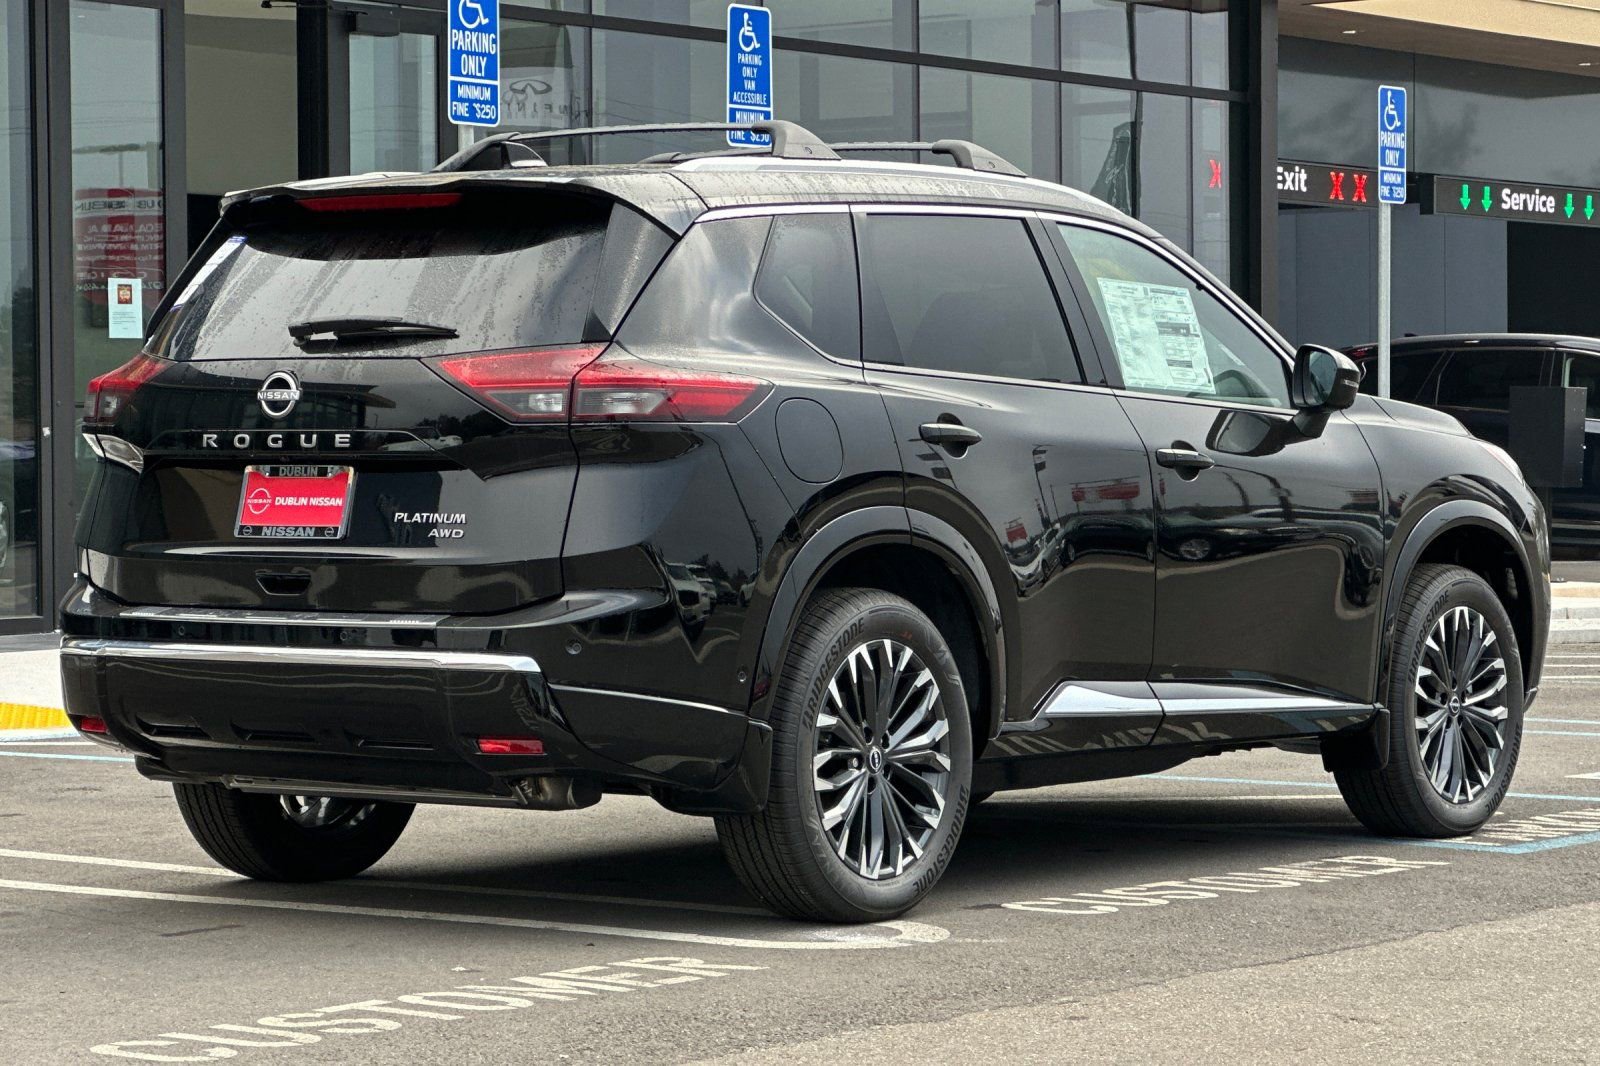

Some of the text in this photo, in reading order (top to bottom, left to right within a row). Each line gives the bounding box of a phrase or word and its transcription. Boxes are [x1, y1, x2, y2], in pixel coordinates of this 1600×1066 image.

[452, 29, 496, 54] PARKING
[461, 54, 487, 76] ONLY
[737, 53, 762, 65] PARKING
[742, 66, 757, 78] ONLY
[744, 80, 756, 90] VAN
[457, 84, 491, 101] MINIMUM
[733, 92, 767, 105] ACCESSIBLE
[452, 102, 469, 117] FINE
[1380, 131, 1405, 149] PARKING
[1385, 149, 1400, 166] ONLY
[1383, 172, 1402, 184] MINIMUM
[1501, 187, 1556, 213] Service
[257, 391, 299, 400] NISSAN
[202, 433, 351, 449] ROGUE
[278, 465, 319, 477] DUBLIN
[275, 496, 343, 507] DUBLIN NISSAN
[393, 512, 467, 525] PLATINUM
[261, 526, 316, 538] NISSAN
[427, 528, 465, 540] AWD
[801, 616, 866, 734] BRIDGESTONE
[1000, 854, 1451, 915] CUSTOMER
[89, 955, 771, 1063] CUSTOMER
